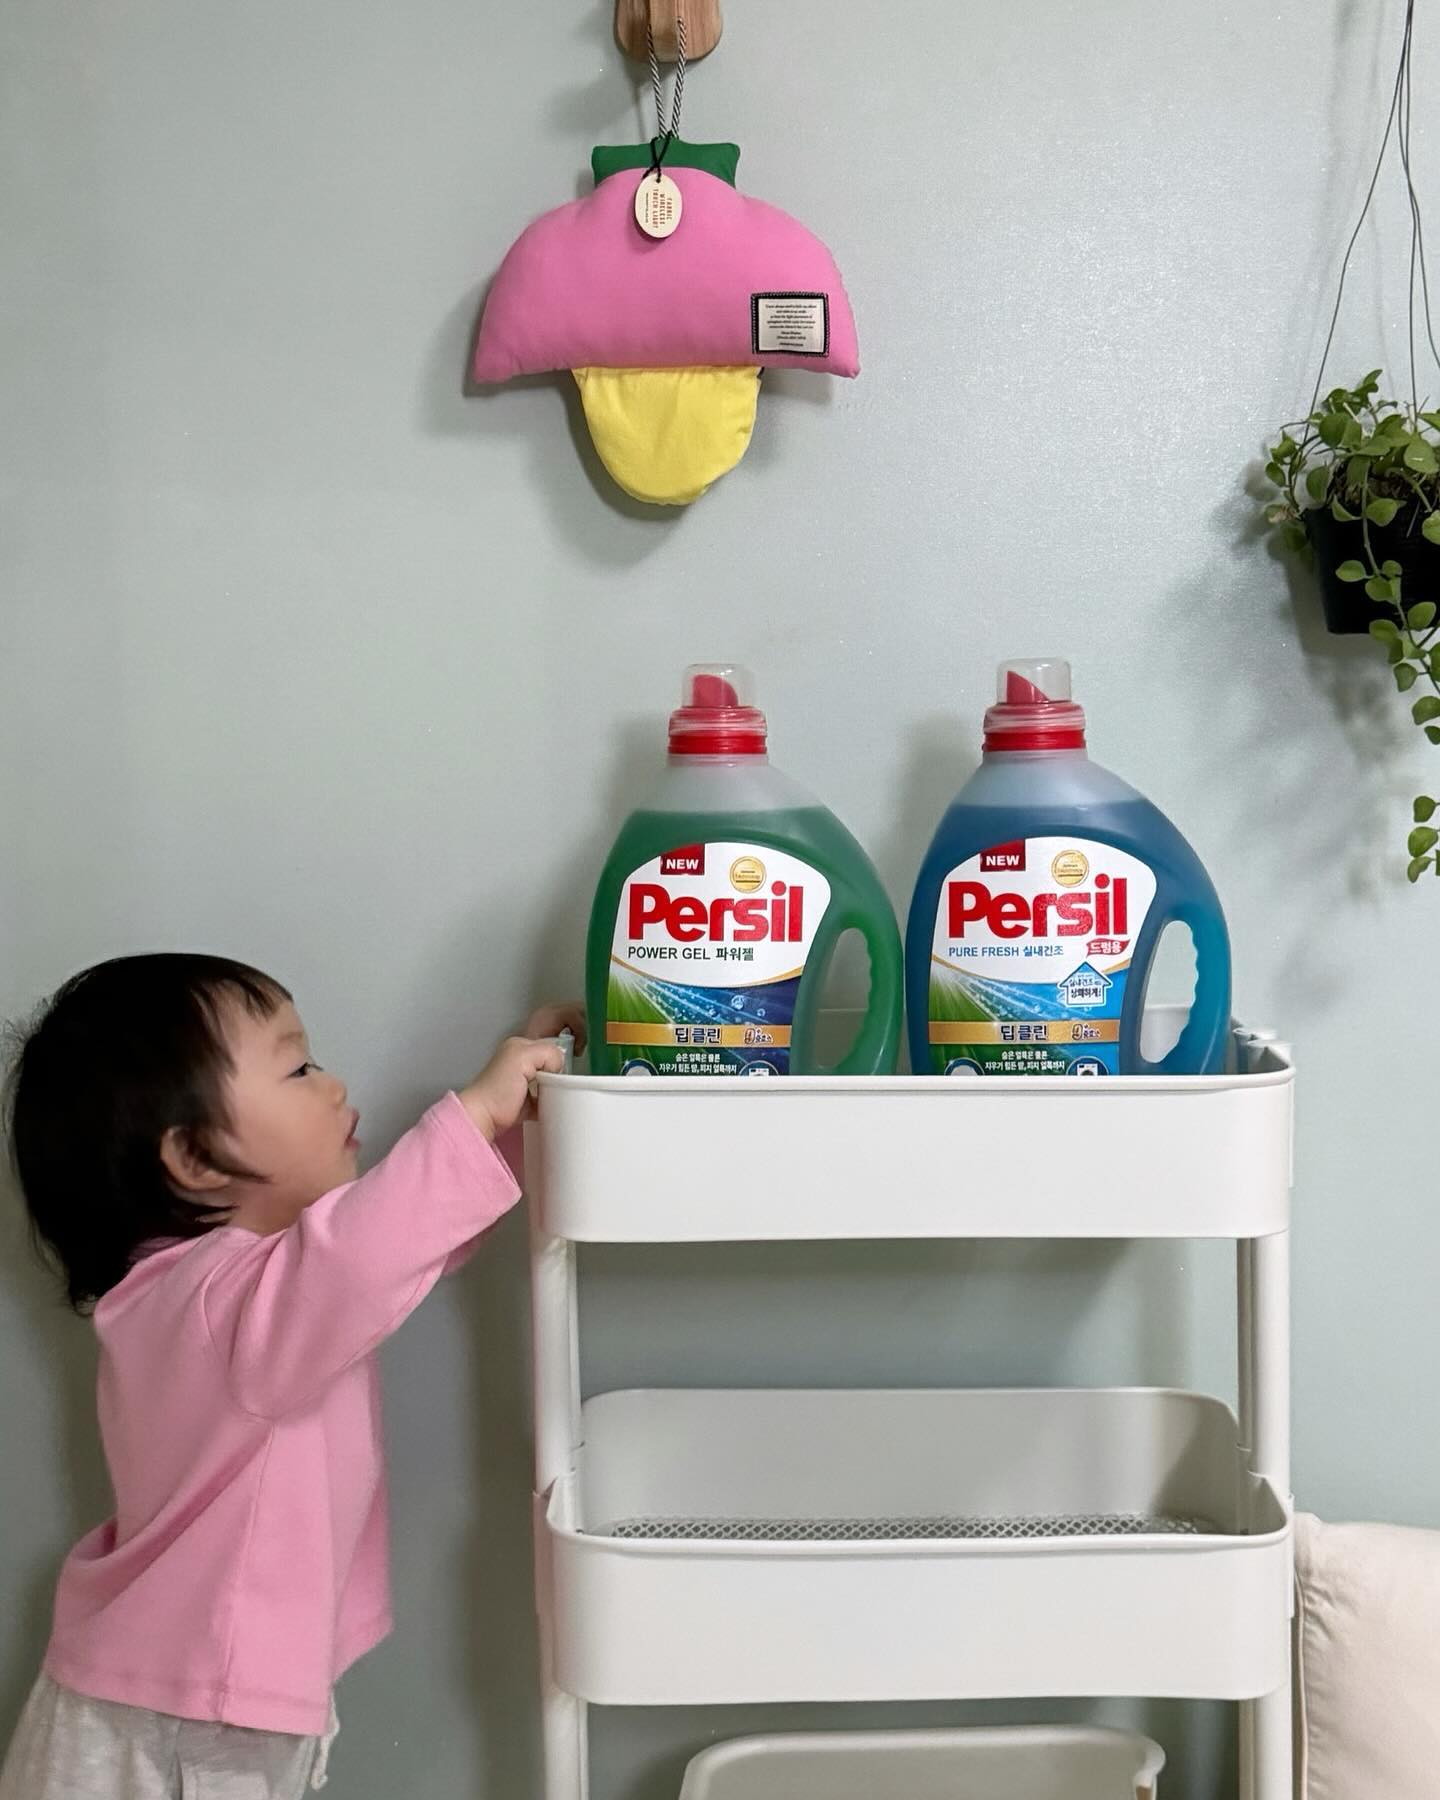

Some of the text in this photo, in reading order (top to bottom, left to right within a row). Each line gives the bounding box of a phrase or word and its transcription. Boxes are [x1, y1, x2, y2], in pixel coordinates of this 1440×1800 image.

[666, 858, 699, 870] NEW
[986, 855, 1019, 866] NEW
[628, 880, 804, 943] Persil
[949, 873, 1128, 939] Persil
[628, 946, 754, 962] POWER GEL 파워젤
[949, 945, 1064, 957] PURE FRESH 실내건조
[1089, 940, 1123, 954] 드럼용
[674, 1027, 721, 1044] 딥클린
[1000, 1025, 1047, 1041] 딥클린
